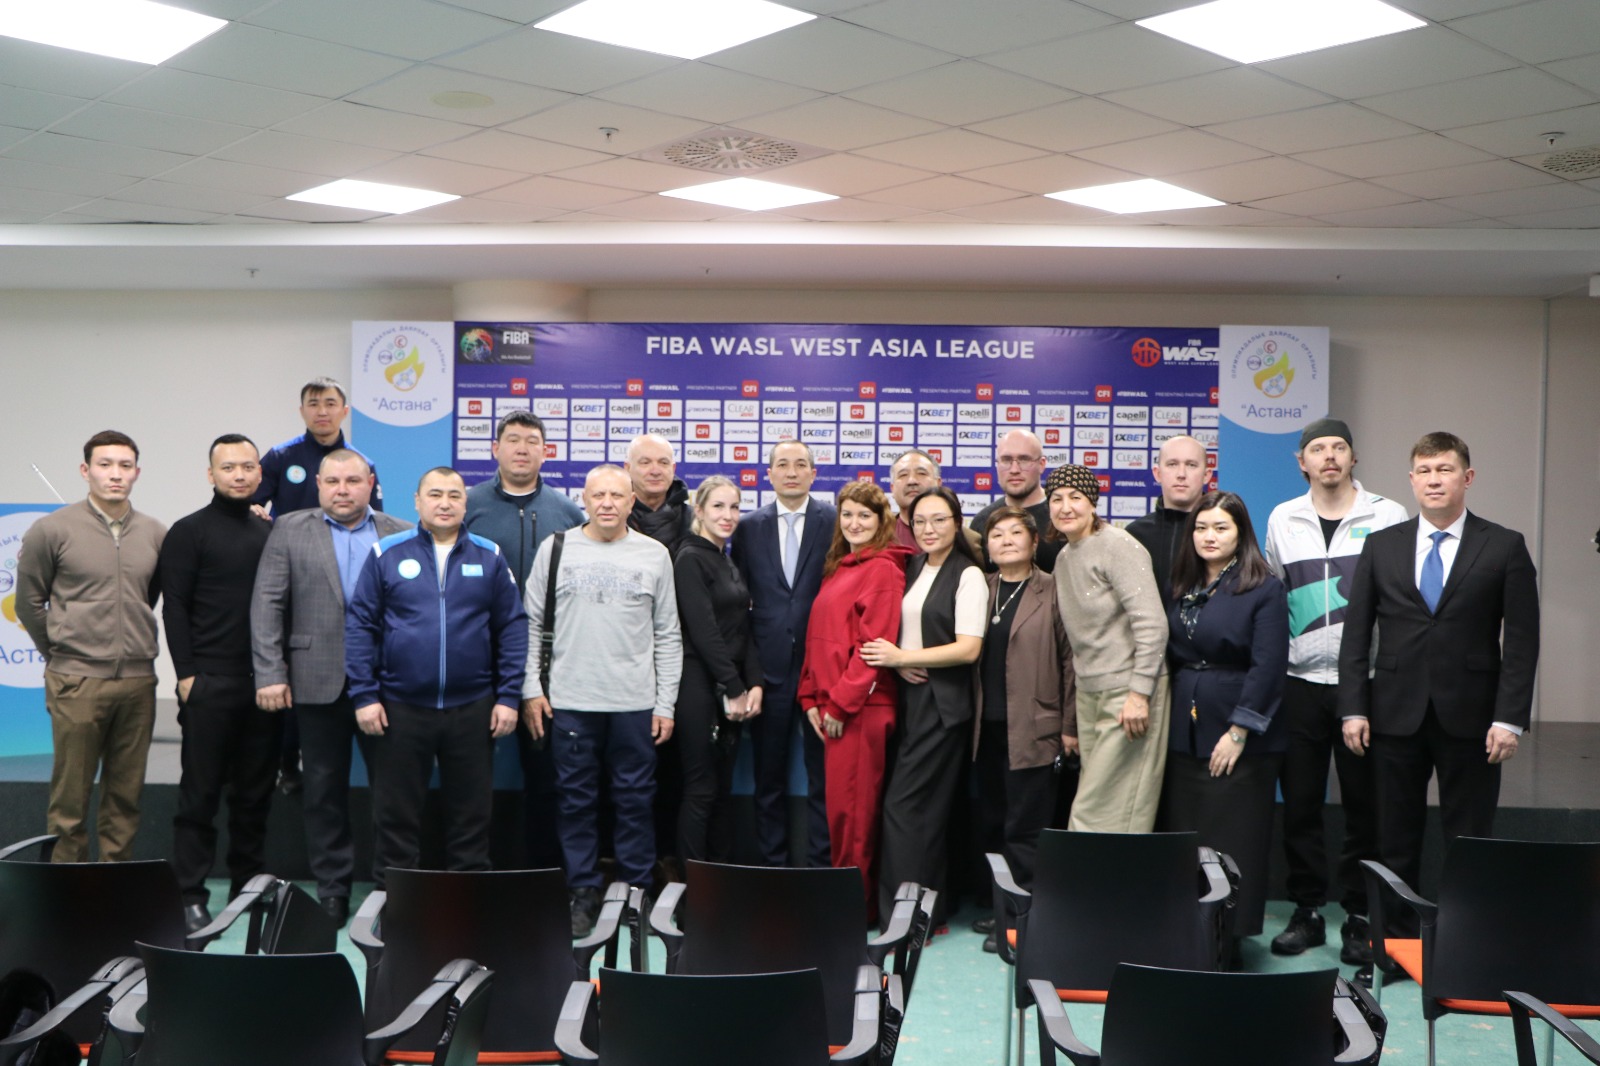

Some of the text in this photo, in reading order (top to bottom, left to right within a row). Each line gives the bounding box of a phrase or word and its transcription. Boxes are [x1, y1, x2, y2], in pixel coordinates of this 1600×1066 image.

[503, 331, 529, 344] FIBA
[646, 336, 1035, 359] FIBA WASL WEST ASIA LEAGUE
[537, 401, 563, 410] CLEAR
[611, 405, 640, 413] capelli
[728, 404, 754, 413] CLEAR
[804, 407, 834, 415] capelli
[960, 409, 989, 418] capelli
[1038, 408, 1065, 417] CLEAR
[1116, 411, 1146, 420] capelli
[1155, 410, 1182, 419] CLEAR
[460, 424, 489, 432] capelli
[575, 423, 601, 432] CLEAR
[649, 426, 678, 434] capelli
[766, 426, 793, 434] CLEAR
[843, 429, 872, 438] capelli
[1077, 430, 1104, 440] CLEAR
[687, 448, 716, 457] capelli
[1116, 453, 1143, 462] CLEAR
[976, 477, 989, 486] CFI
